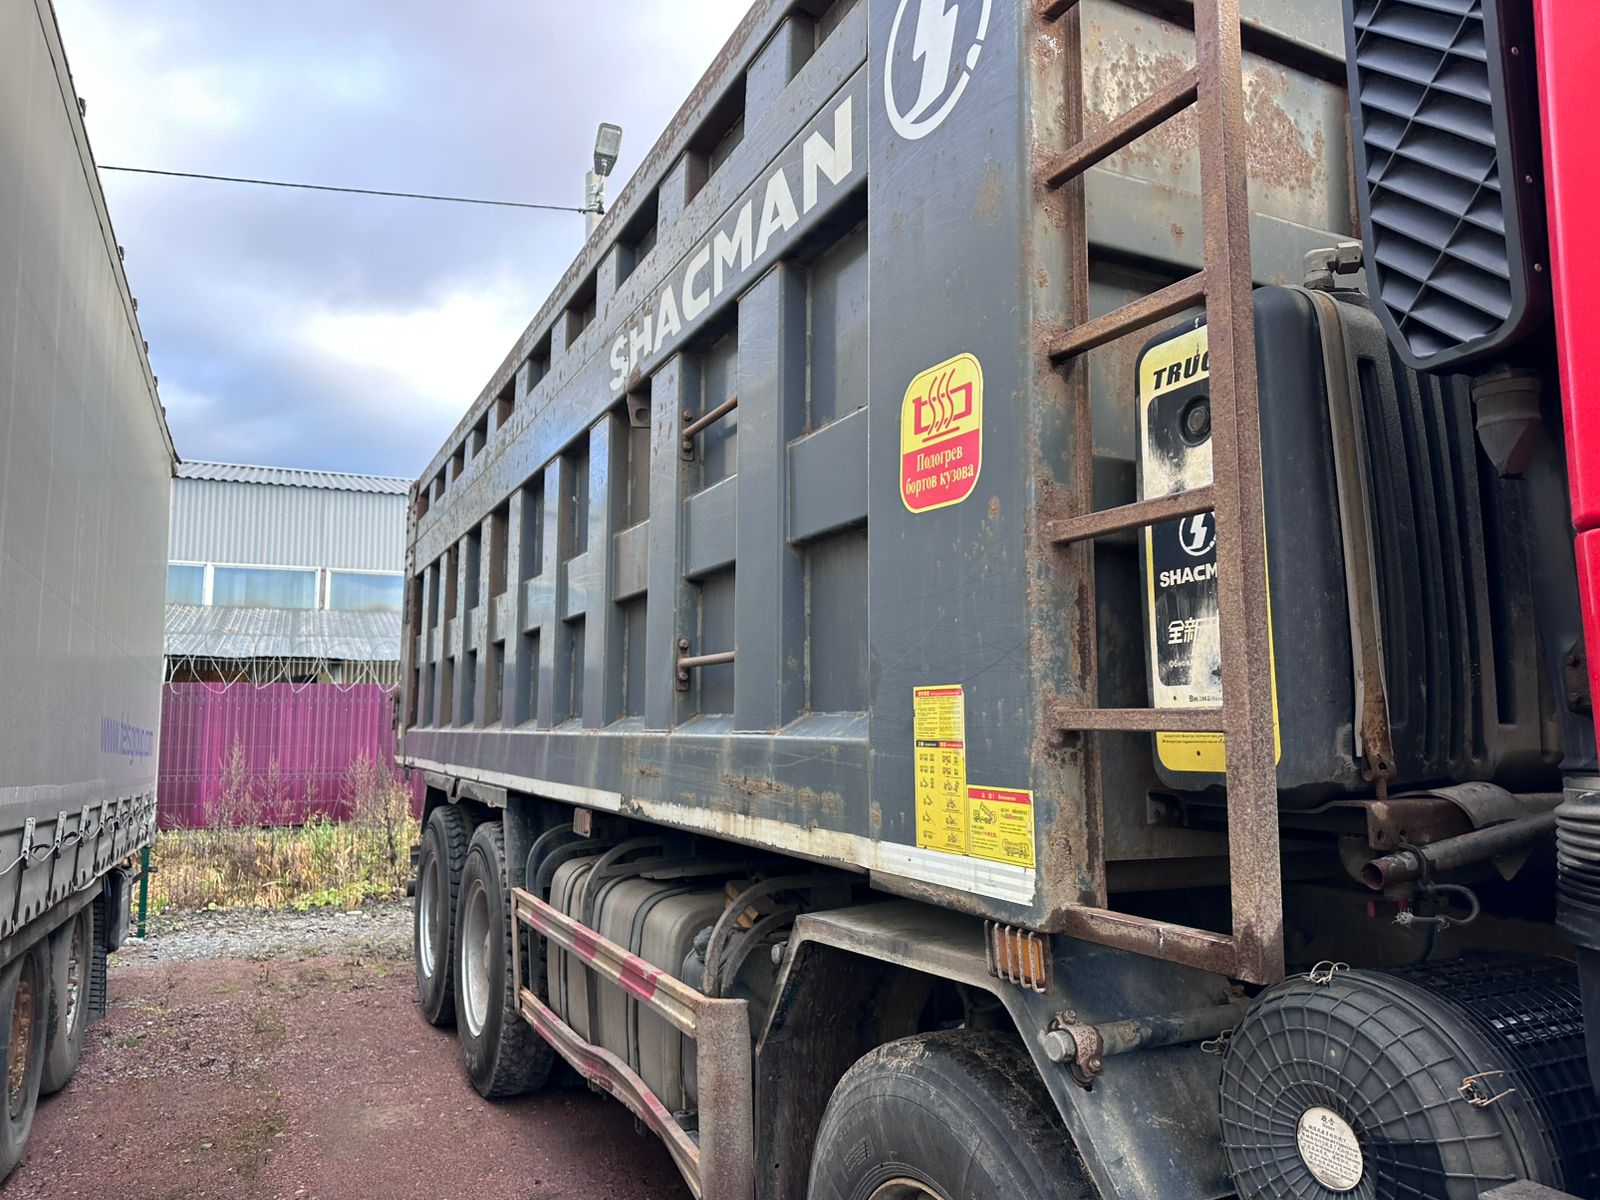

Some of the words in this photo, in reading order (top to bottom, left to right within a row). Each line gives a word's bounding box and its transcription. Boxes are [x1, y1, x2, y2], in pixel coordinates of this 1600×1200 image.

[608, 94, 853, 391] SHACMAN
[916, 445, 963, 472] Подогрев
[905, 475, 937, 497] бортов
[939, 463, 974, 489] кузова
